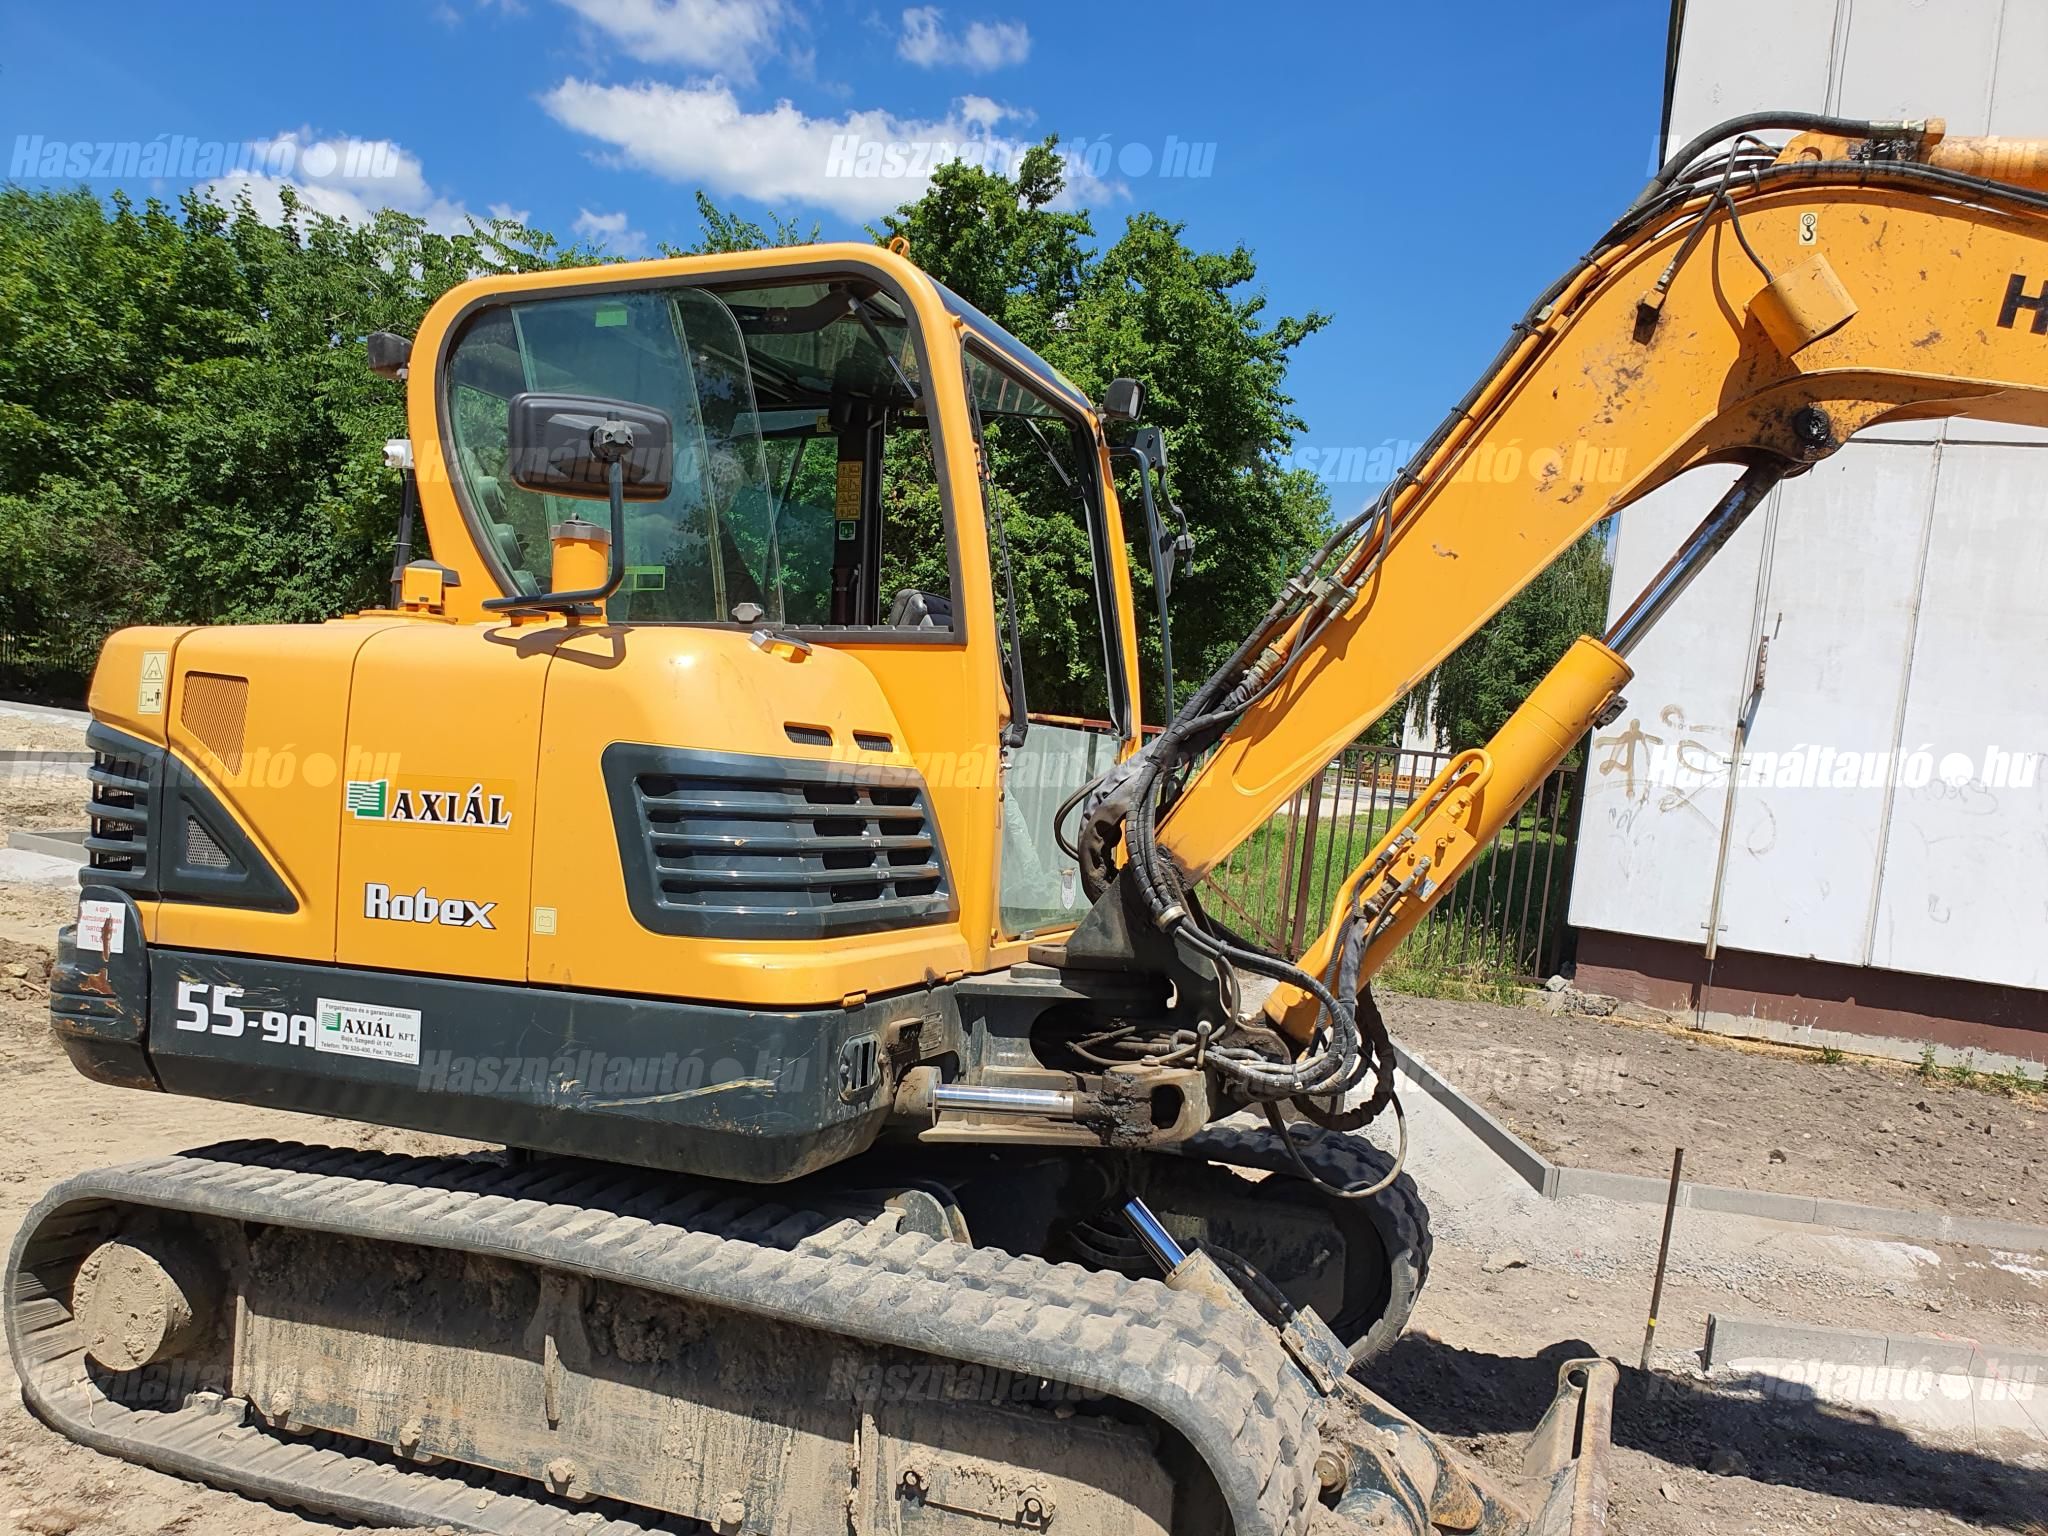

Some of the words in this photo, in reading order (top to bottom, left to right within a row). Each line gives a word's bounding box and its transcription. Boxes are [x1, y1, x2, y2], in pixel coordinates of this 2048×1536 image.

[390, 784, 512, 829] AXIÁL
[364, 882, 499, 930] Robex
[176, 981, 316, 1048] 55-9A
[342, 1017, 394, 1038] AXIÁL
[398, 1032, 417, 1042] KFT.
